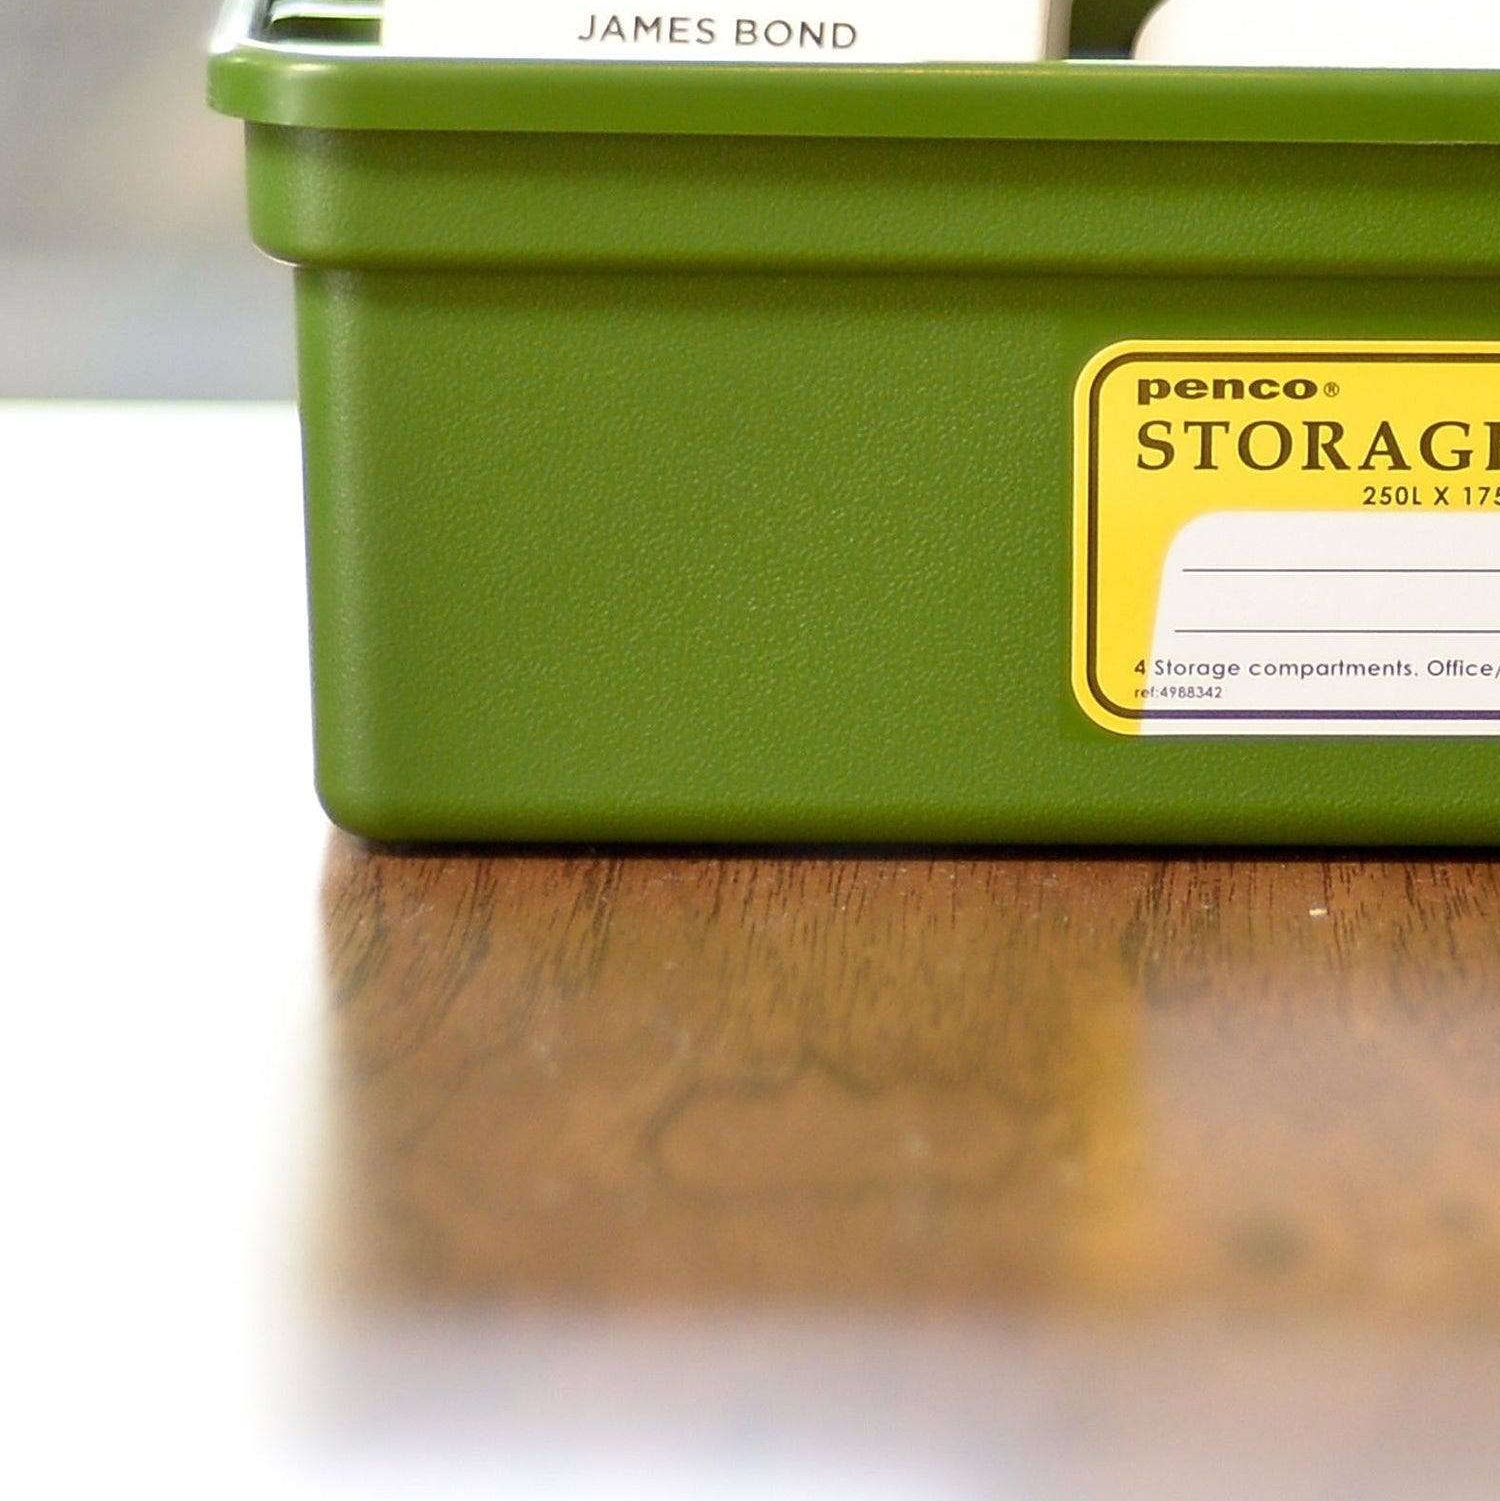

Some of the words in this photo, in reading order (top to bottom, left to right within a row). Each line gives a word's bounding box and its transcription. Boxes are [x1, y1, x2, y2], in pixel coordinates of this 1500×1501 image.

[578, 14, 716, 45] JAMES
[735, 18, 858, 49] BOND
[1362, 485, 1422, 506] 250L
[1433, 486, 1450, 506] X
[1134, 659, 1147, 676] 4
[1154, 659, 1241, 680] Storage
[1248, 659, 1419, 680] compartments.
[1134, 686, 1222, 699] ref:4988342
